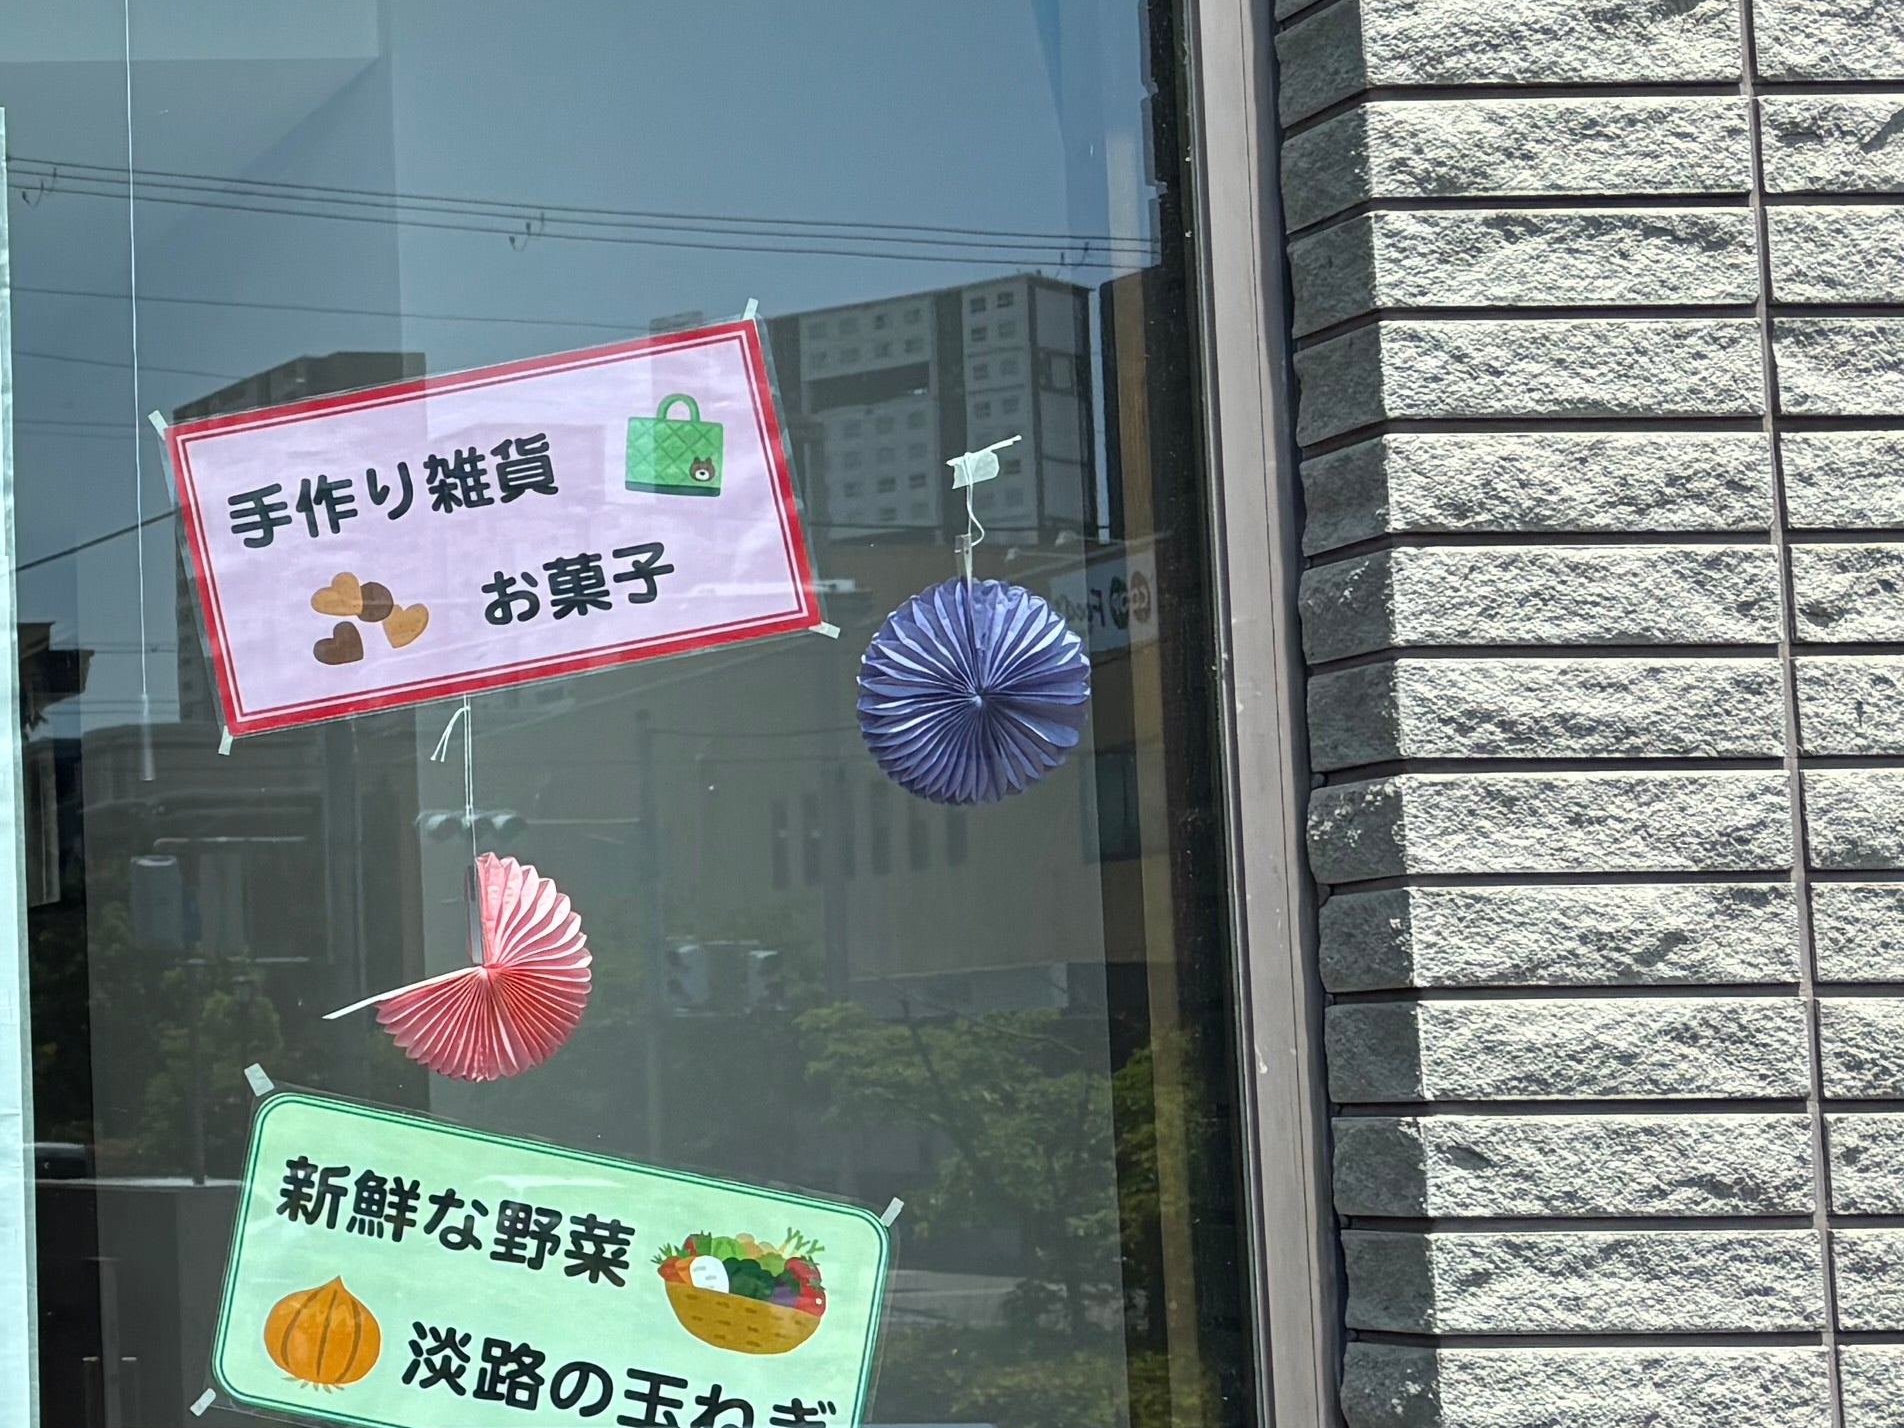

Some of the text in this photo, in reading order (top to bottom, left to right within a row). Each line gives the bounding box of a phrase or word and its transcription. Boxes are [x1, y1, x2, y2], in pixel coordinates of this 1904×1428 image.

[228, 432, 559, 549] 手作り雑貨
[481, 541, 675, 626] お菓子
[276, 1155, 637, 1289] 新鮮な野菜
